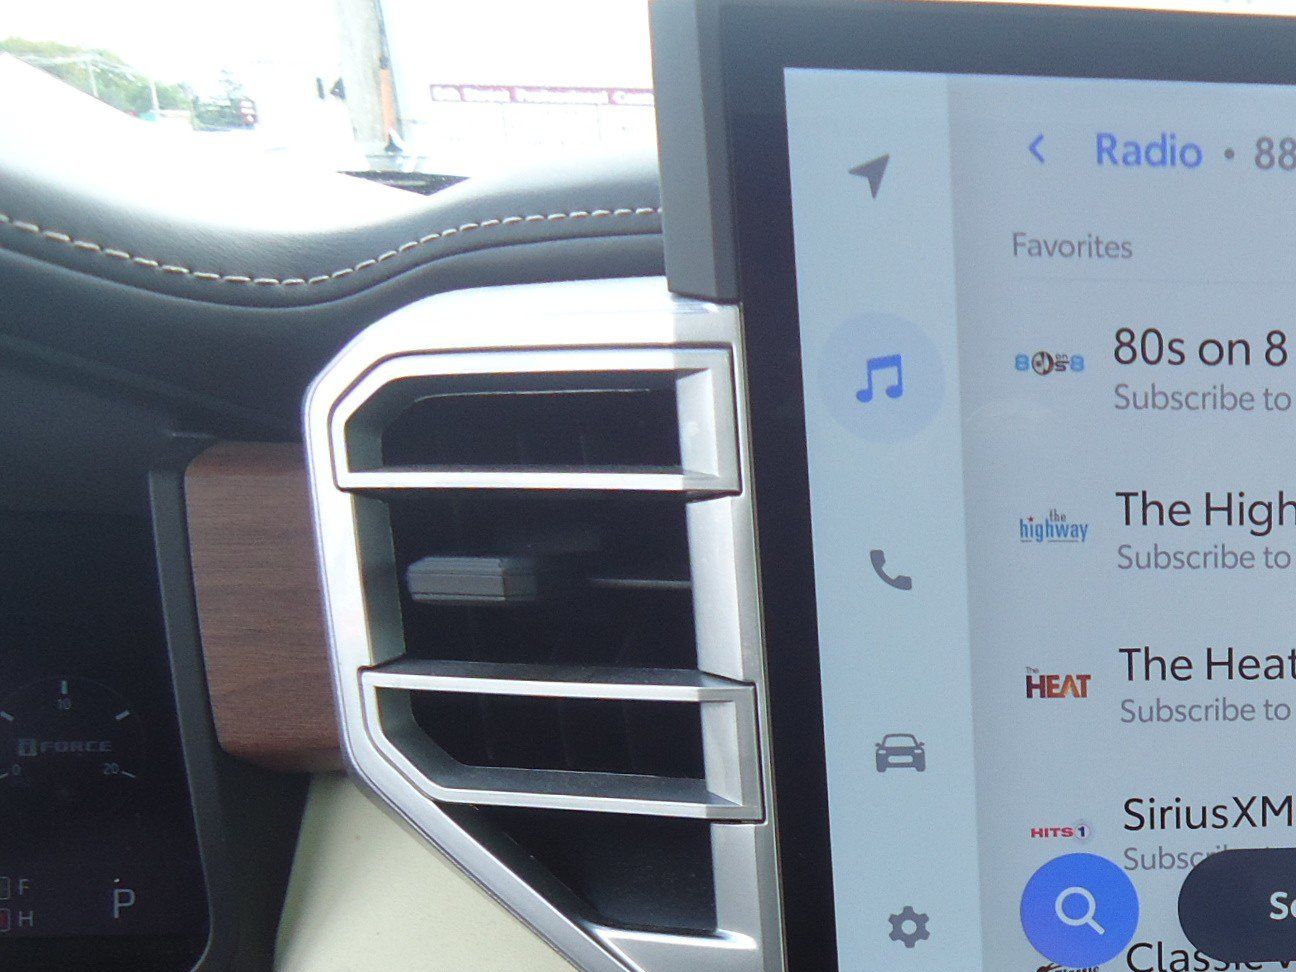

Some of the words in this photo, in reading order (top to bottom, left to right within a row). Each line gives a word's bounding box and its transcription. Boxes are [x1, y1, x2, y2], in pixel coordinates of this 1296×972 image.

[1095, 132, 1203, 169] Radio
[1011, 232, 1134, 260] Favorites
[1113, 327, 1186, 367] 80s
[1198, 337, 1252, 366] on
[1264, 330, 1289, 366] 8
[1113, 385, 1255, 412] Subscribe
[1263, 388, 1292, 412] to
[1115, 491, 1191, 528] The
[1019, 518, 1089, 543] highway
[1117, 544, 1255, 570] Subscribe
[1263, 546, 1292, 570] to
[1119, 648, 1192, 681] The
[1026, 674, 1091, 698] HEAT
[1120, 699, 1256, 724] Subscribe
[1263, 701, 1291, 723] to
[1123, 795, 1293, 831] SiriusXM
[1030, 827, 1073, 838] HITS
[113, 888, 137, 919] P
